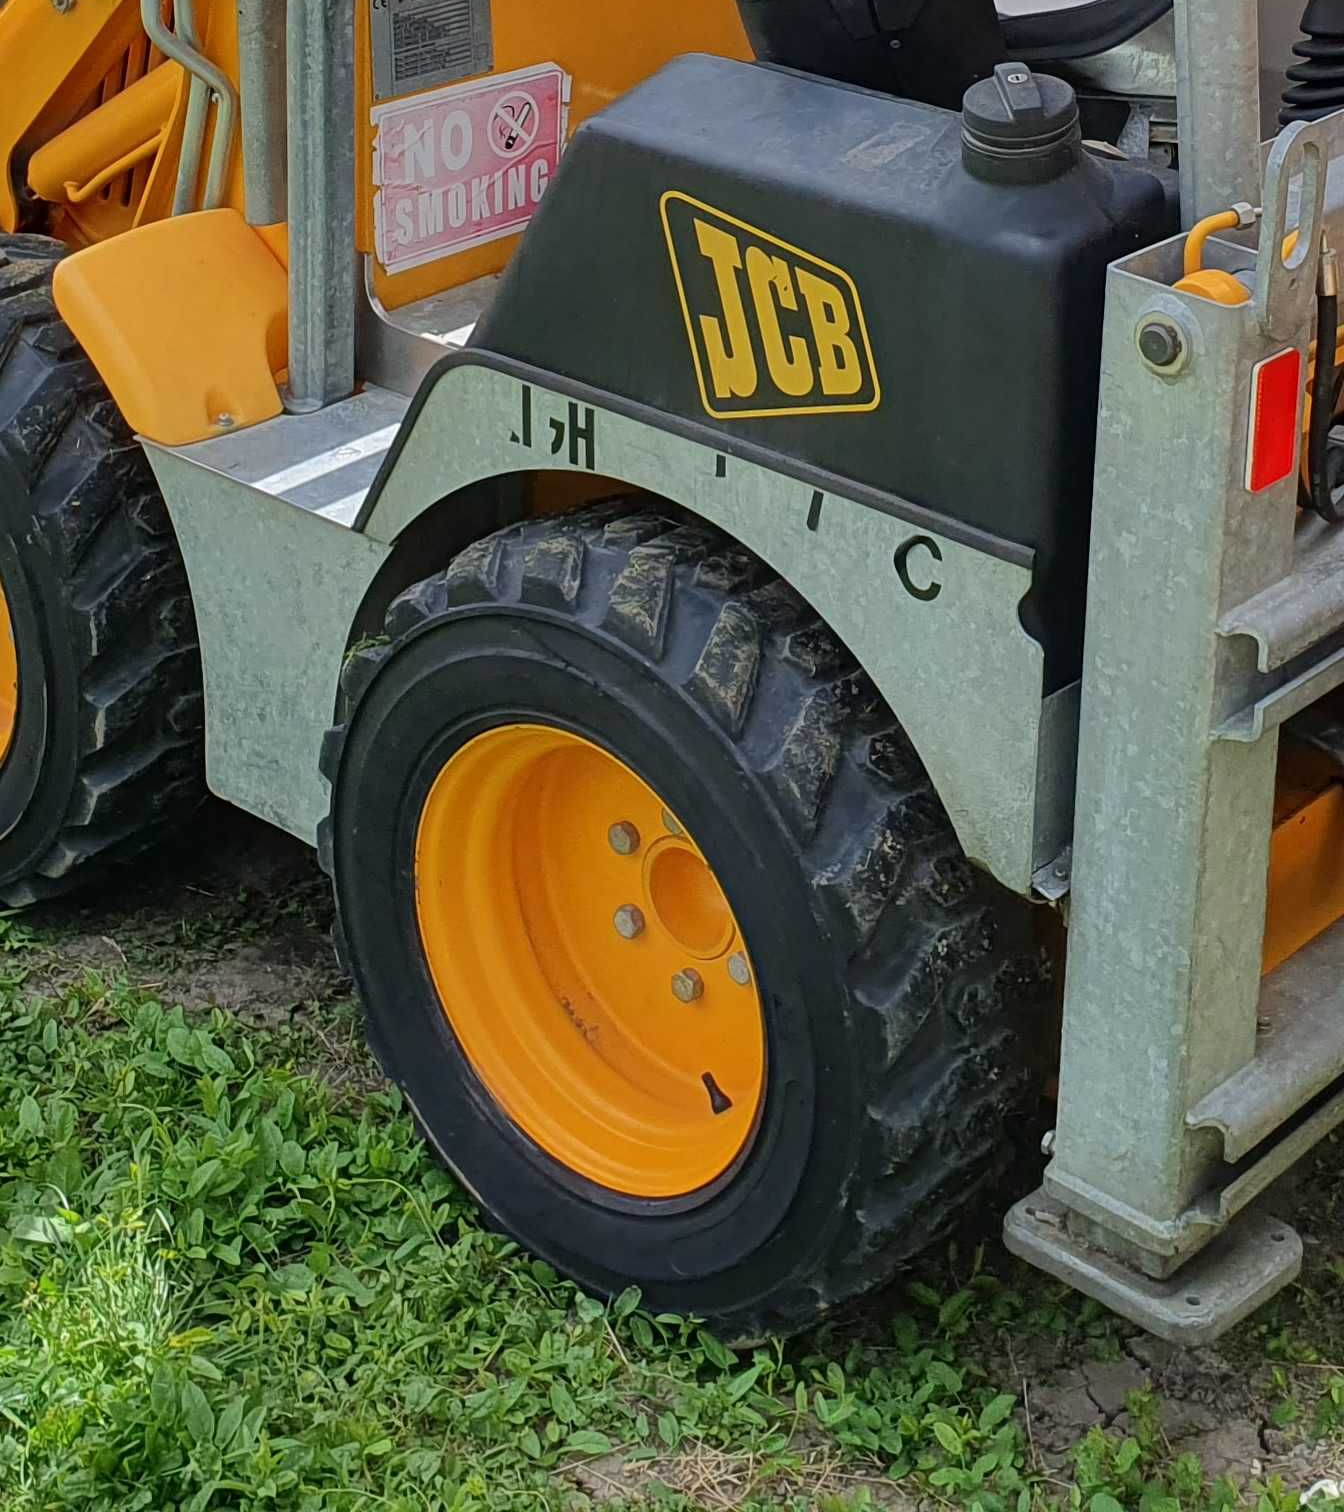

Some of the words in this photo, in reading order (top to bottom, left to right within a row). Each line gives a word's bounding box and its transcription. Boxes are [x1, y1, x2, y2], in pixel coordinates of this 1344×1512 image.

[403, 110, 473, 183] NO
[395, 158, 550, 246] SMOKING
[693, 217, 863, 399] JCB
